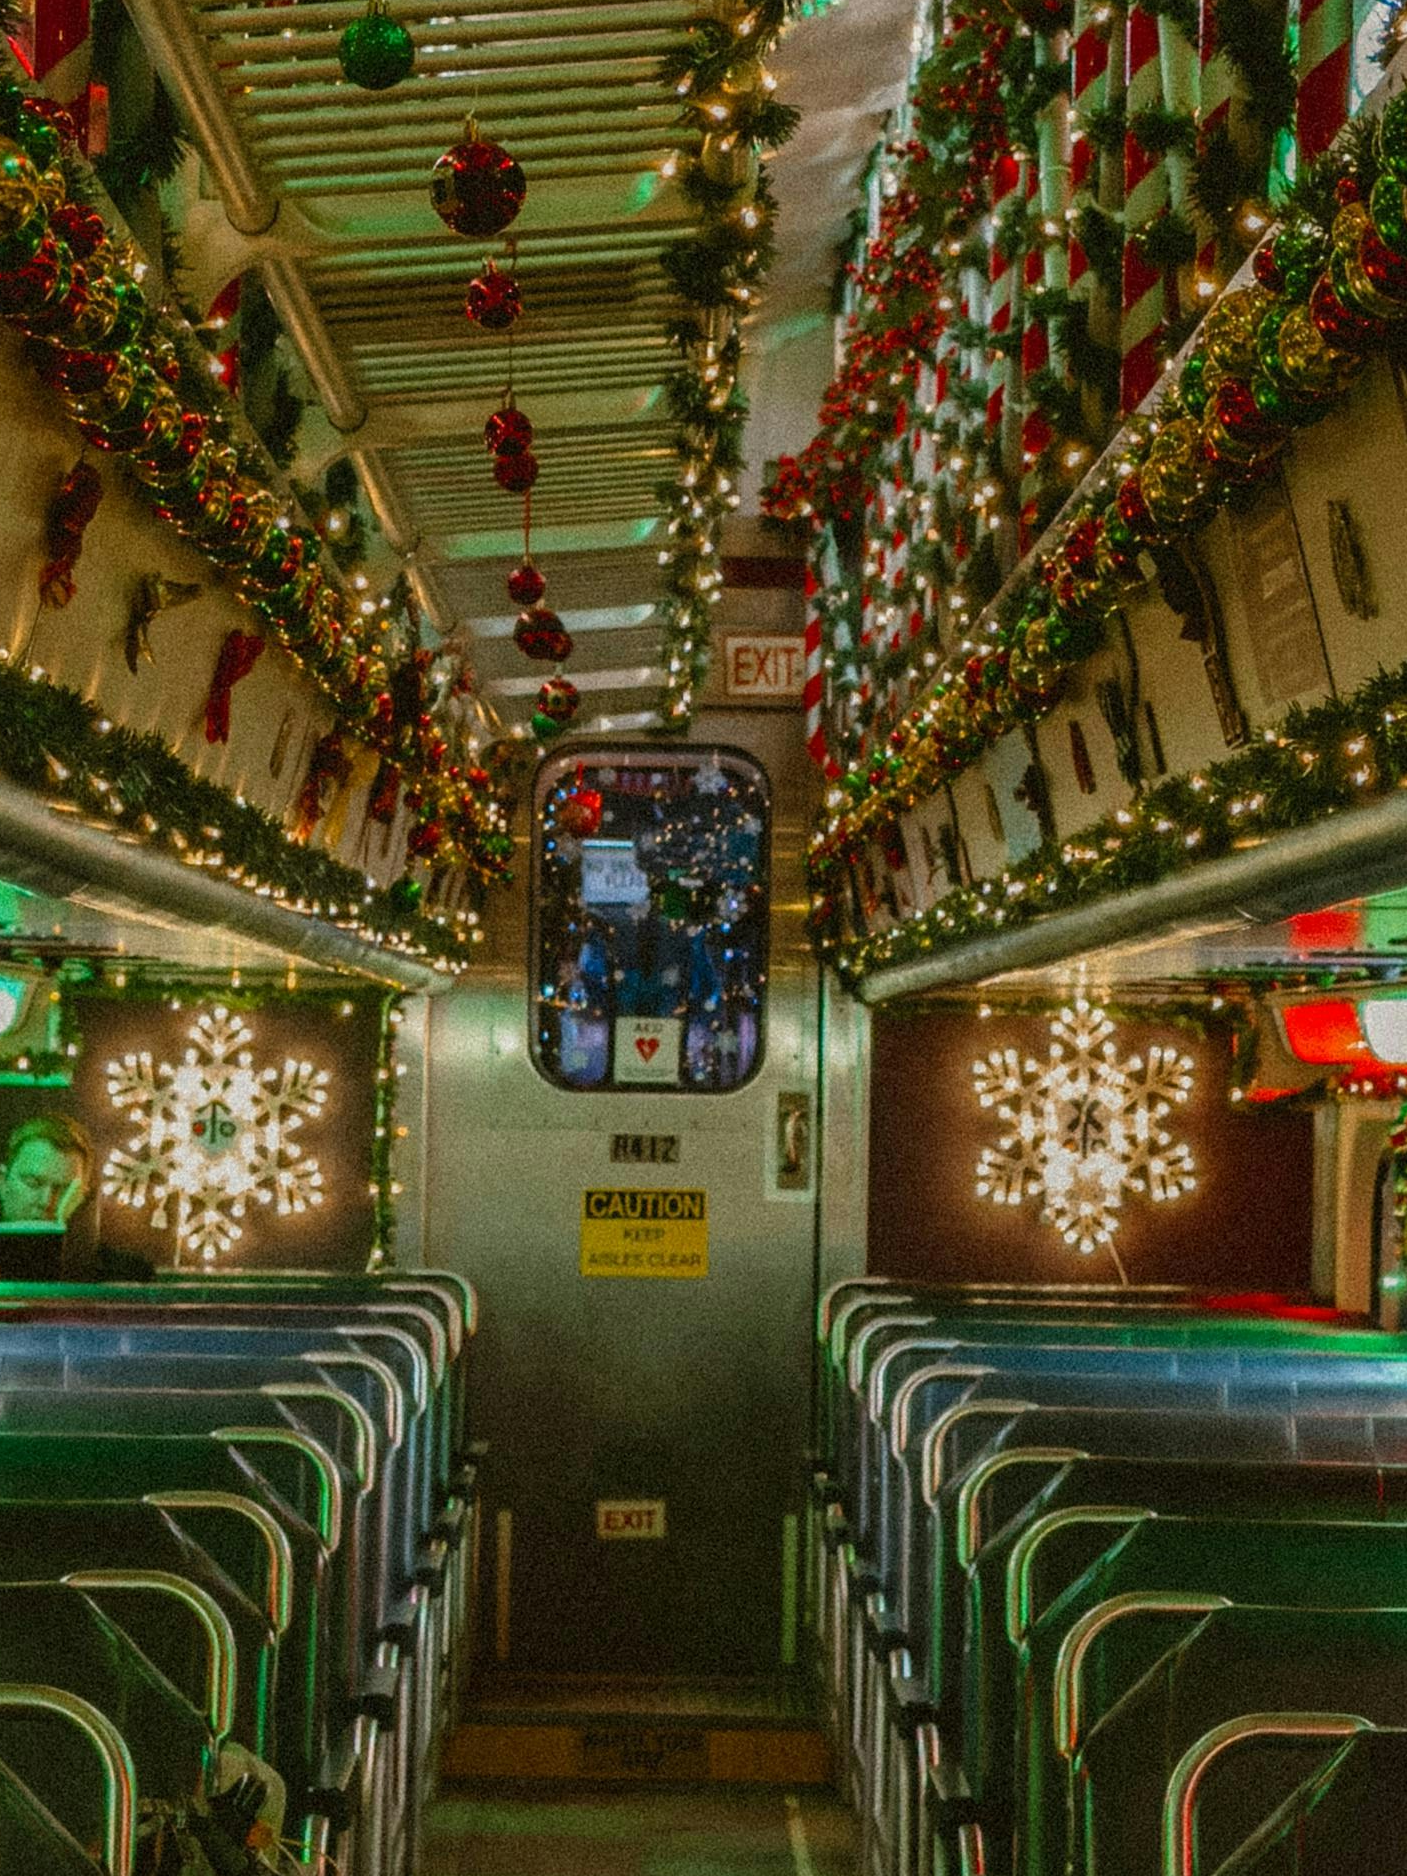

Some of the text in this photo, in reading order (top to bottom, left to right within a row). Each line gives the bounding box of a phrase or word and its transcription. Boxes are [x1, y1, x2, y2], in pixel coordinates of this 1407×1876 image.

[734, 647, 798, 685] EXIT
[589, 1193, 702, 1218] CAUTION
[648, 1253, 702, 1268] CLEAR
[604, 1510, 656, 1530] EXIT
